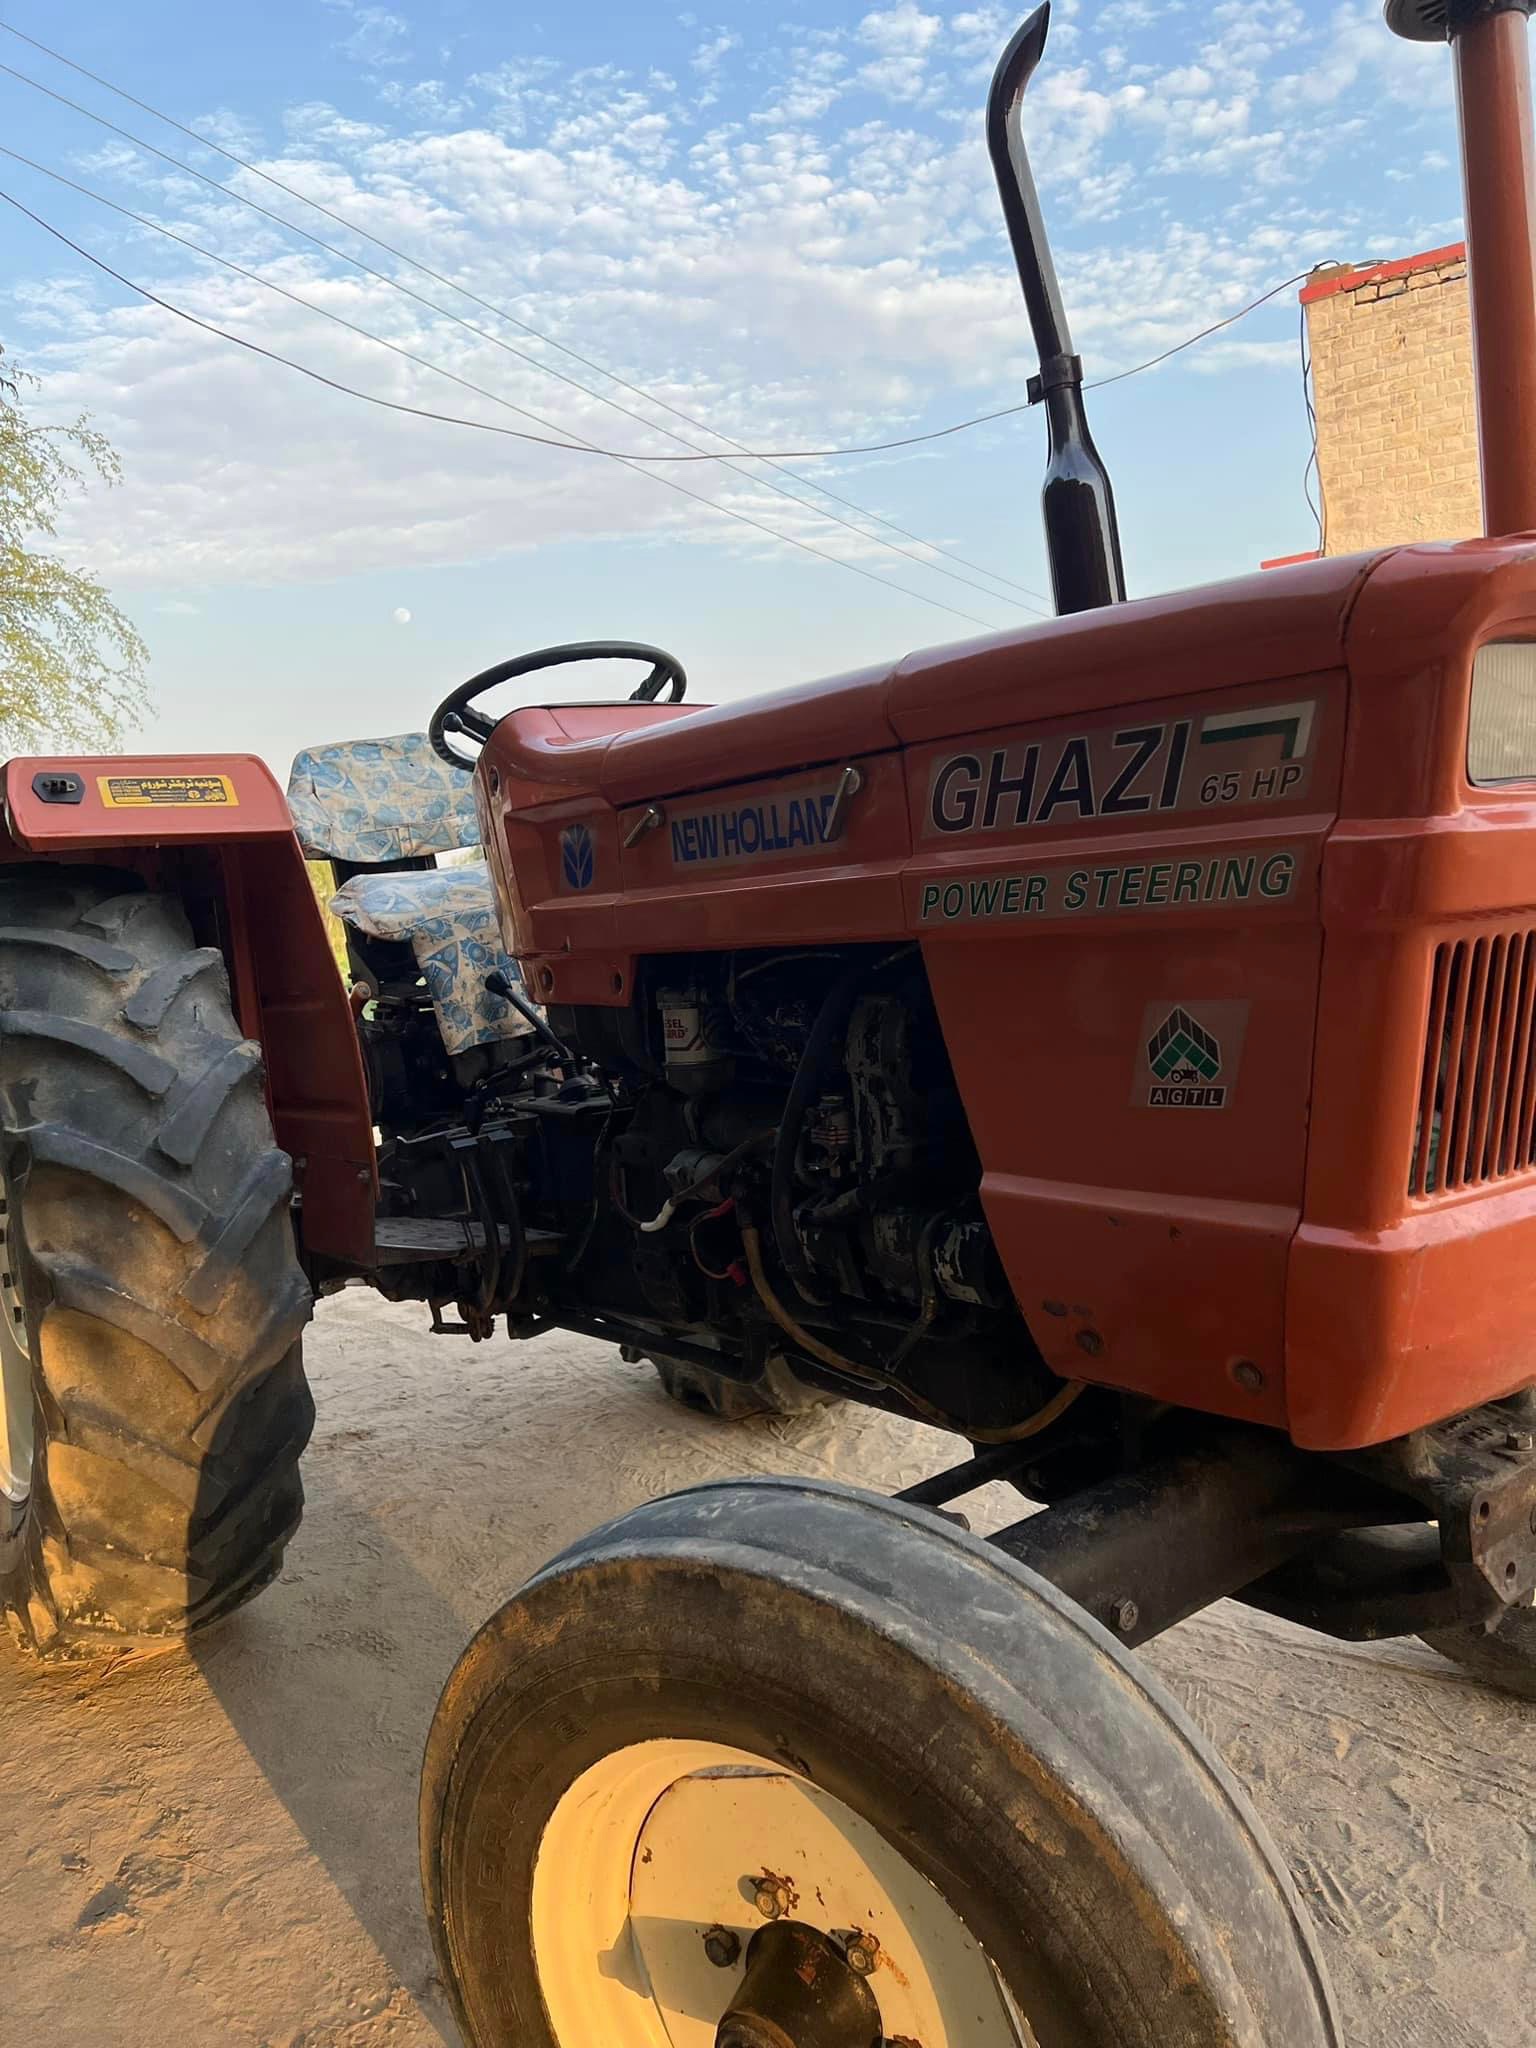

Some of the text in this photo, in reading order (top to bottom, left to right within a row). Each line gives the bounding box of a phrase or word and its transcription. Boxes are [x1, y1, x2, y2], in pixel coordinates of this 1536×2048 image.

[931, 720, 1192, 833] GHAZI
[1200, 765, 1304, 803] 65 HP
[672, 814, 719, 863] NEW
[921, 852, 1296, 920] POWER STEERING
[1151, 1088, 1221, 1105] AGTL
